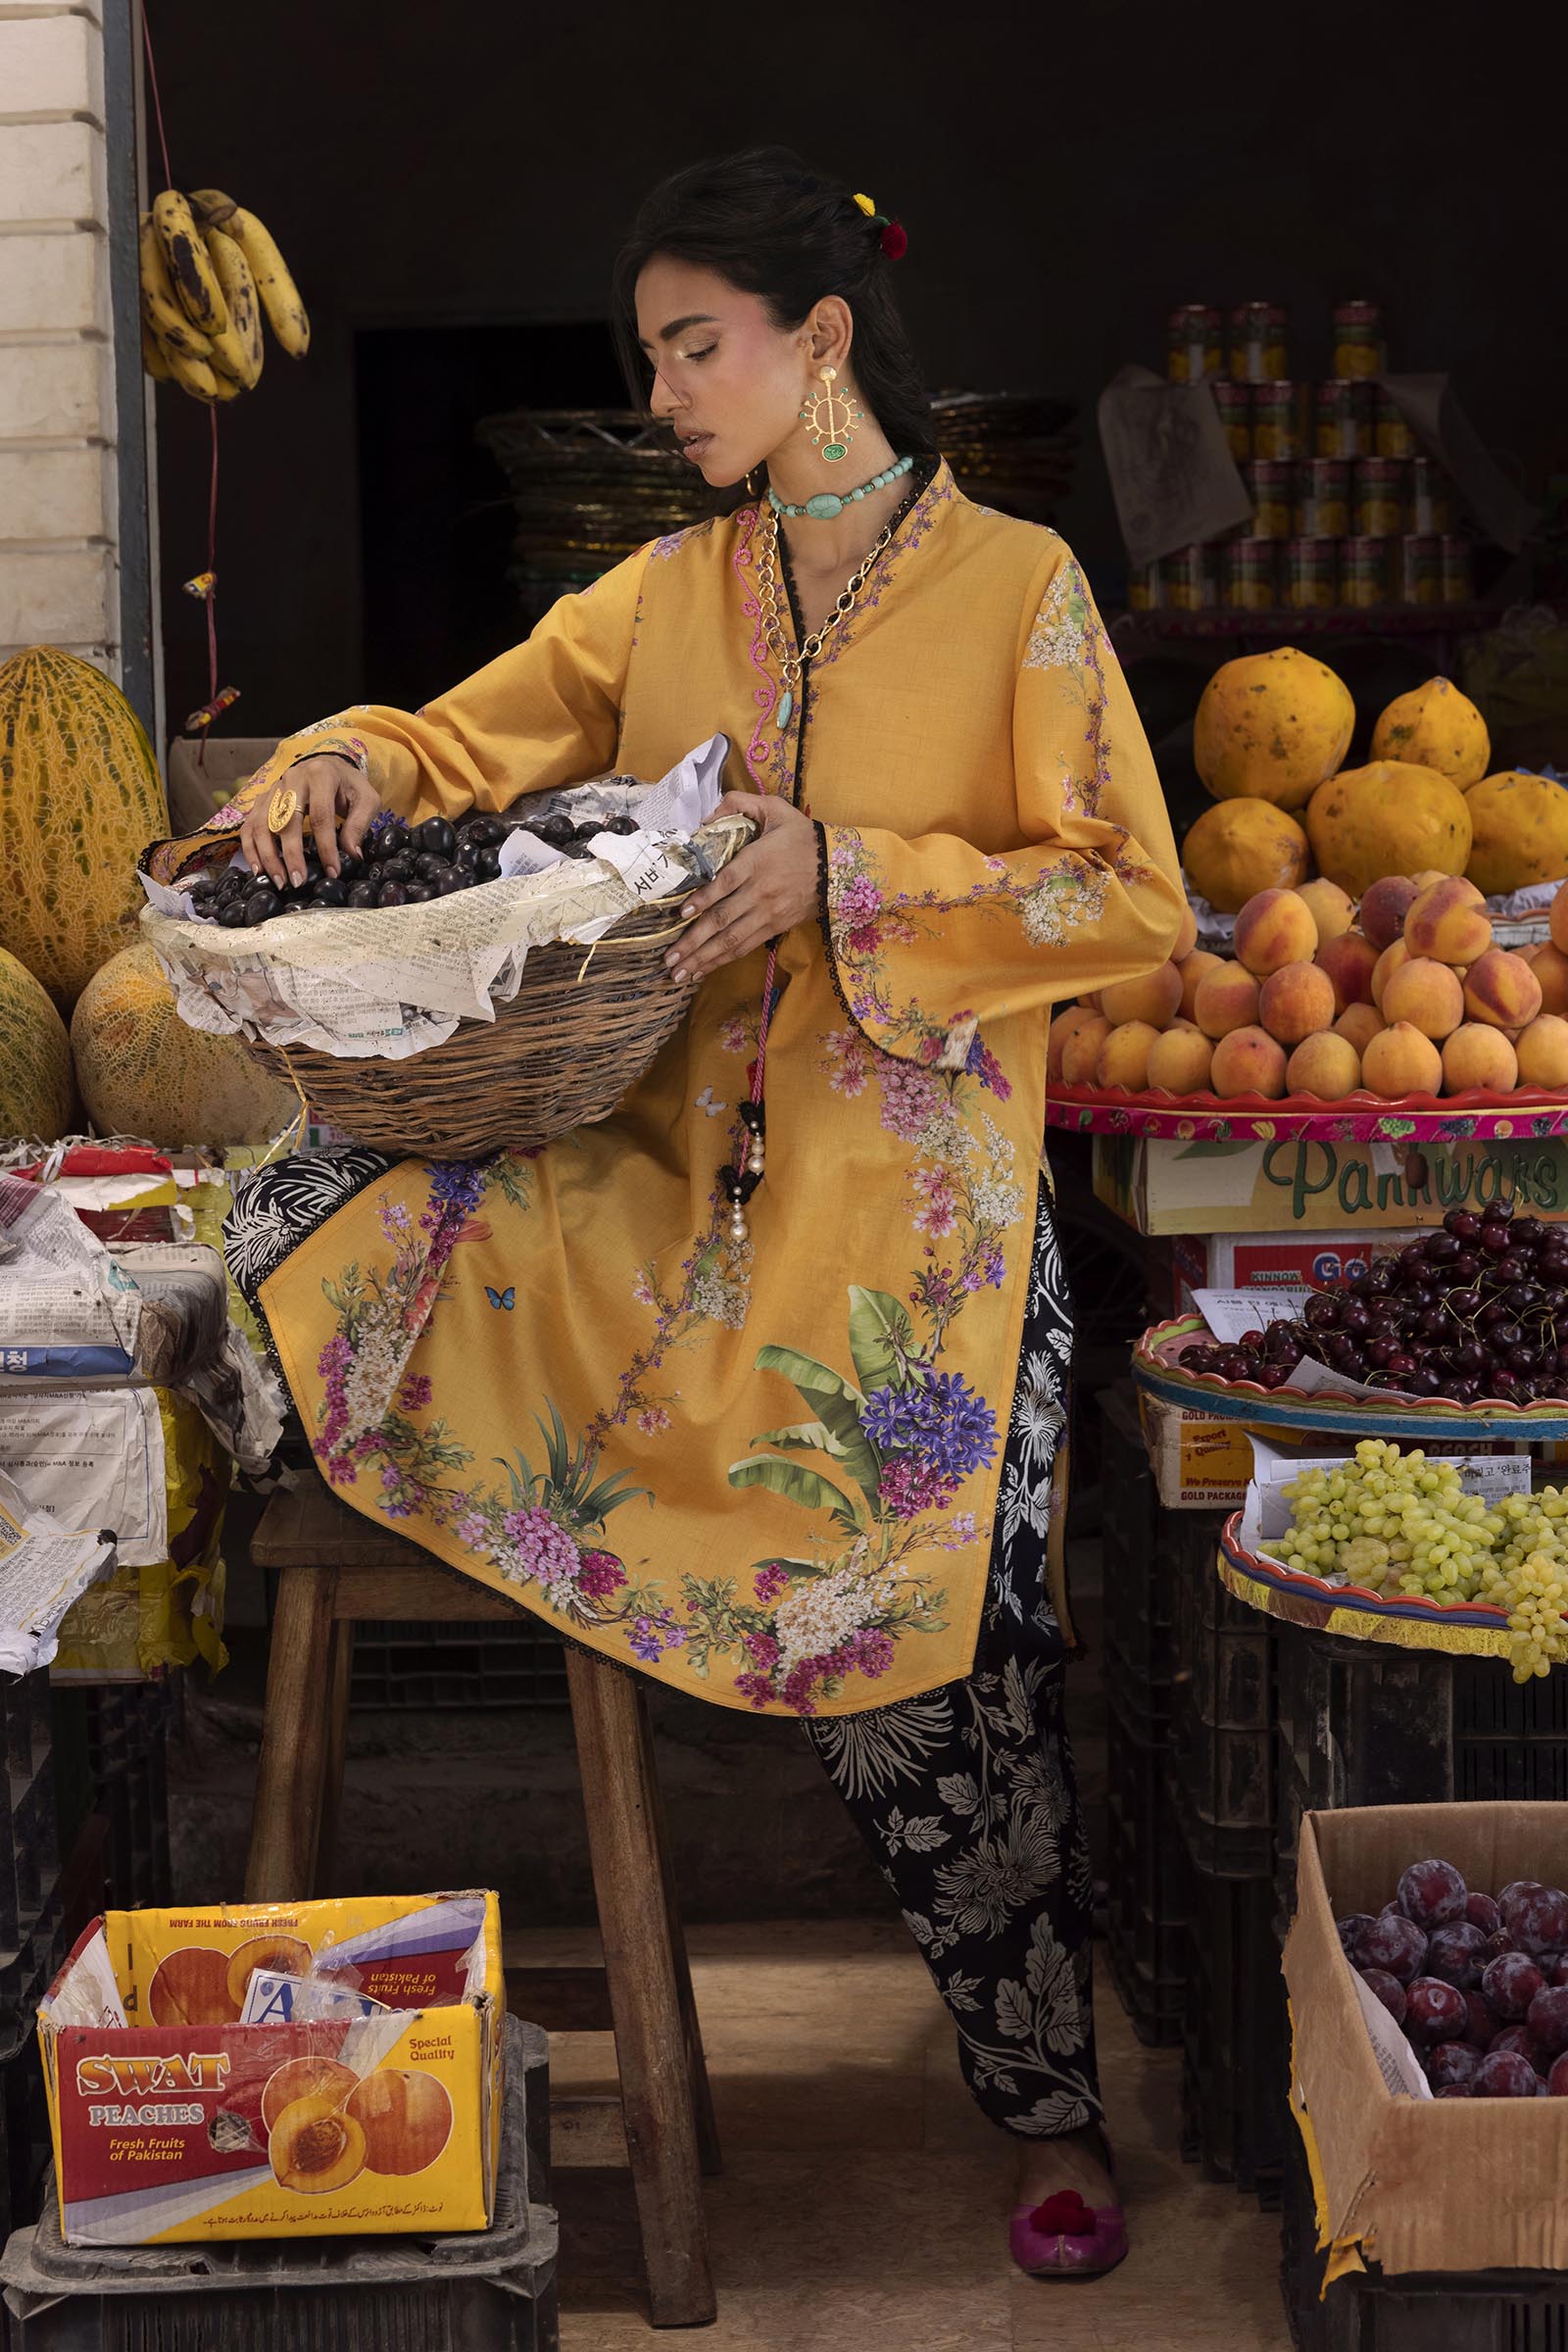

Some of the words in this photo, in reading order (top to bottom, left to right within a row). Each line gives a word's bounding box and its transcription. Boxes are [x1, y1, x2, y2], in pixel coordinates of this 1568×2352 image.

[1182, 1410, 1205, 1420] GOLD
[1201, 1477, 1242, 1487] Preserve
[1181, 1491, 1204, 1501] GOLD
[196, 1919, 212, 1928] THE
[271, 1919, 299, 1928] FRESH
[370, 1972, 420, 1984] Pakistan
[422, 1974, 436, 1984] of
[368, 1983, 399, 1995] Fruits
[403, 1984, 436, 1996] Fresh
[409, 2035, 452, 2050] Special
[410, 2048, 455, 2061] Quality
[76, 2052, 231, 2096] SWAT
[88, 2103, 205, 2127] PEACHES
[110, 2138, 144, 2149] Fresh
[148, 2137, 185, 2149] Fruits
[110, 2149, 124, 2161] of
[127, 2149, 182, 2161] Pakistan
